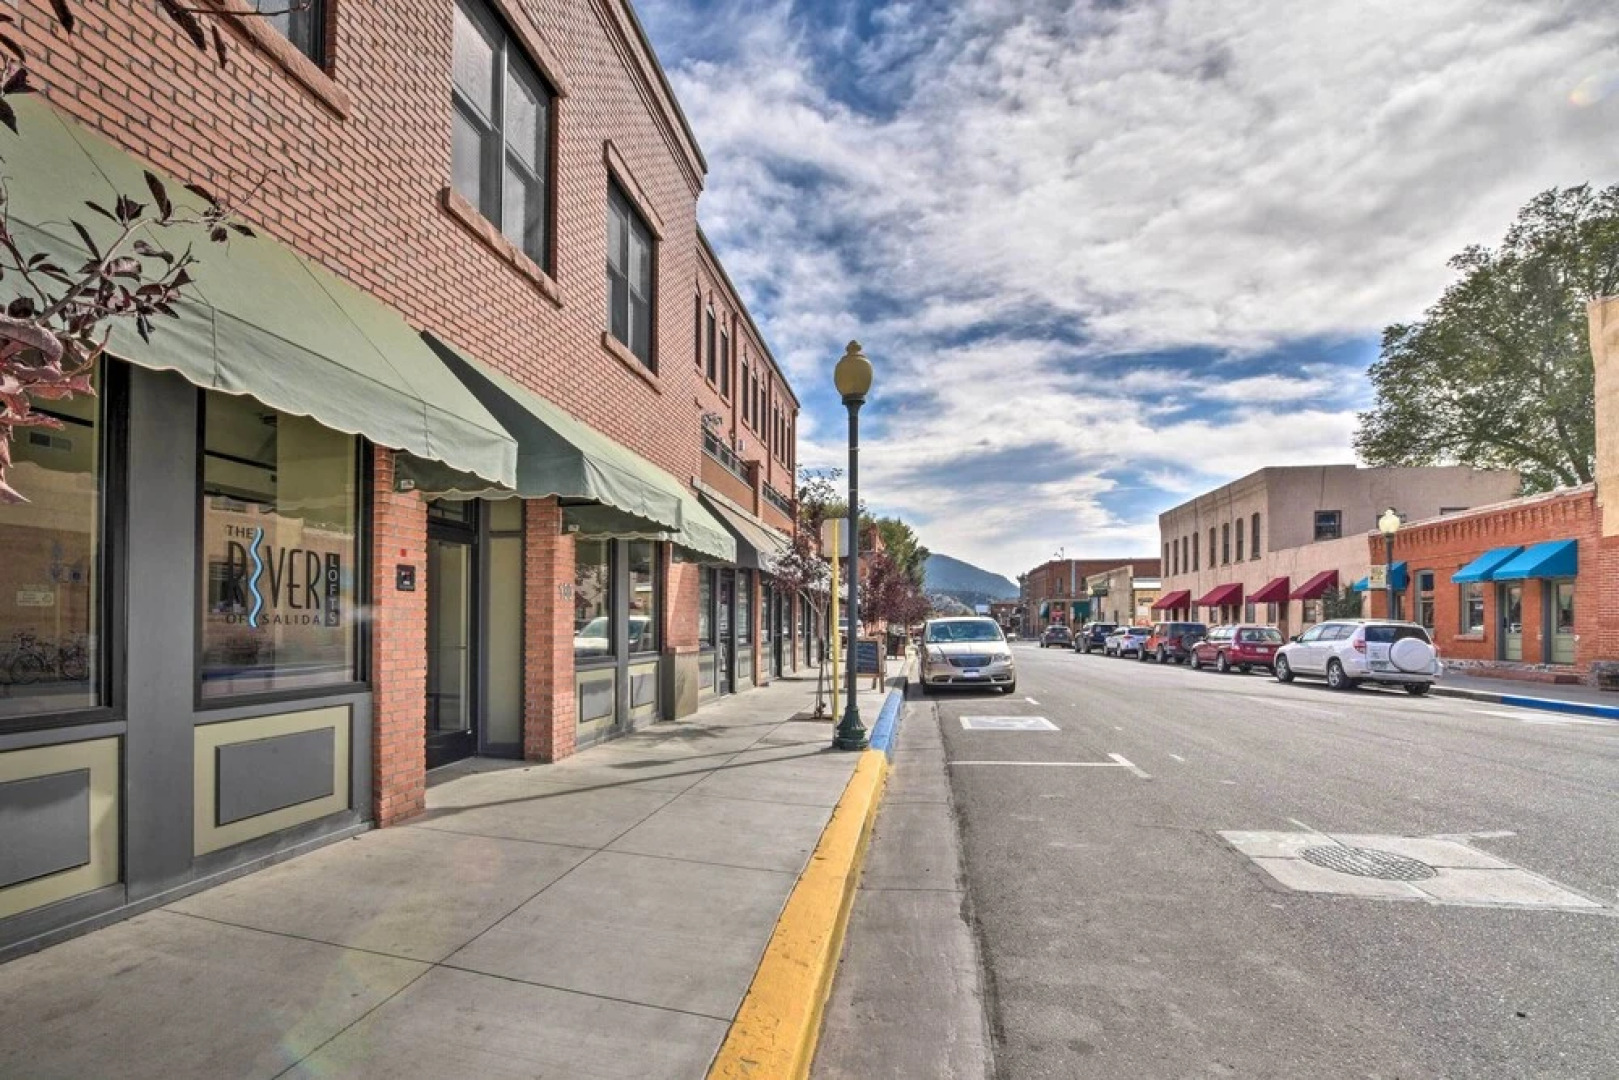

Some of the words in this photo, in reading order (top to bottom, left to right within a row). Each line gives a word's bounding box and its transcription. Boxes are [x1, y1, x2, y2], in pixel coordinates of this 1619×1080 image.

[226, 524, 254, 540] THE
[227, 538, 321, 613] RIVER
[327, 554, 338, 625] LOFTS
[226, 613, 247, 625] OF
[261, 613, 321, 626] SALIDA
